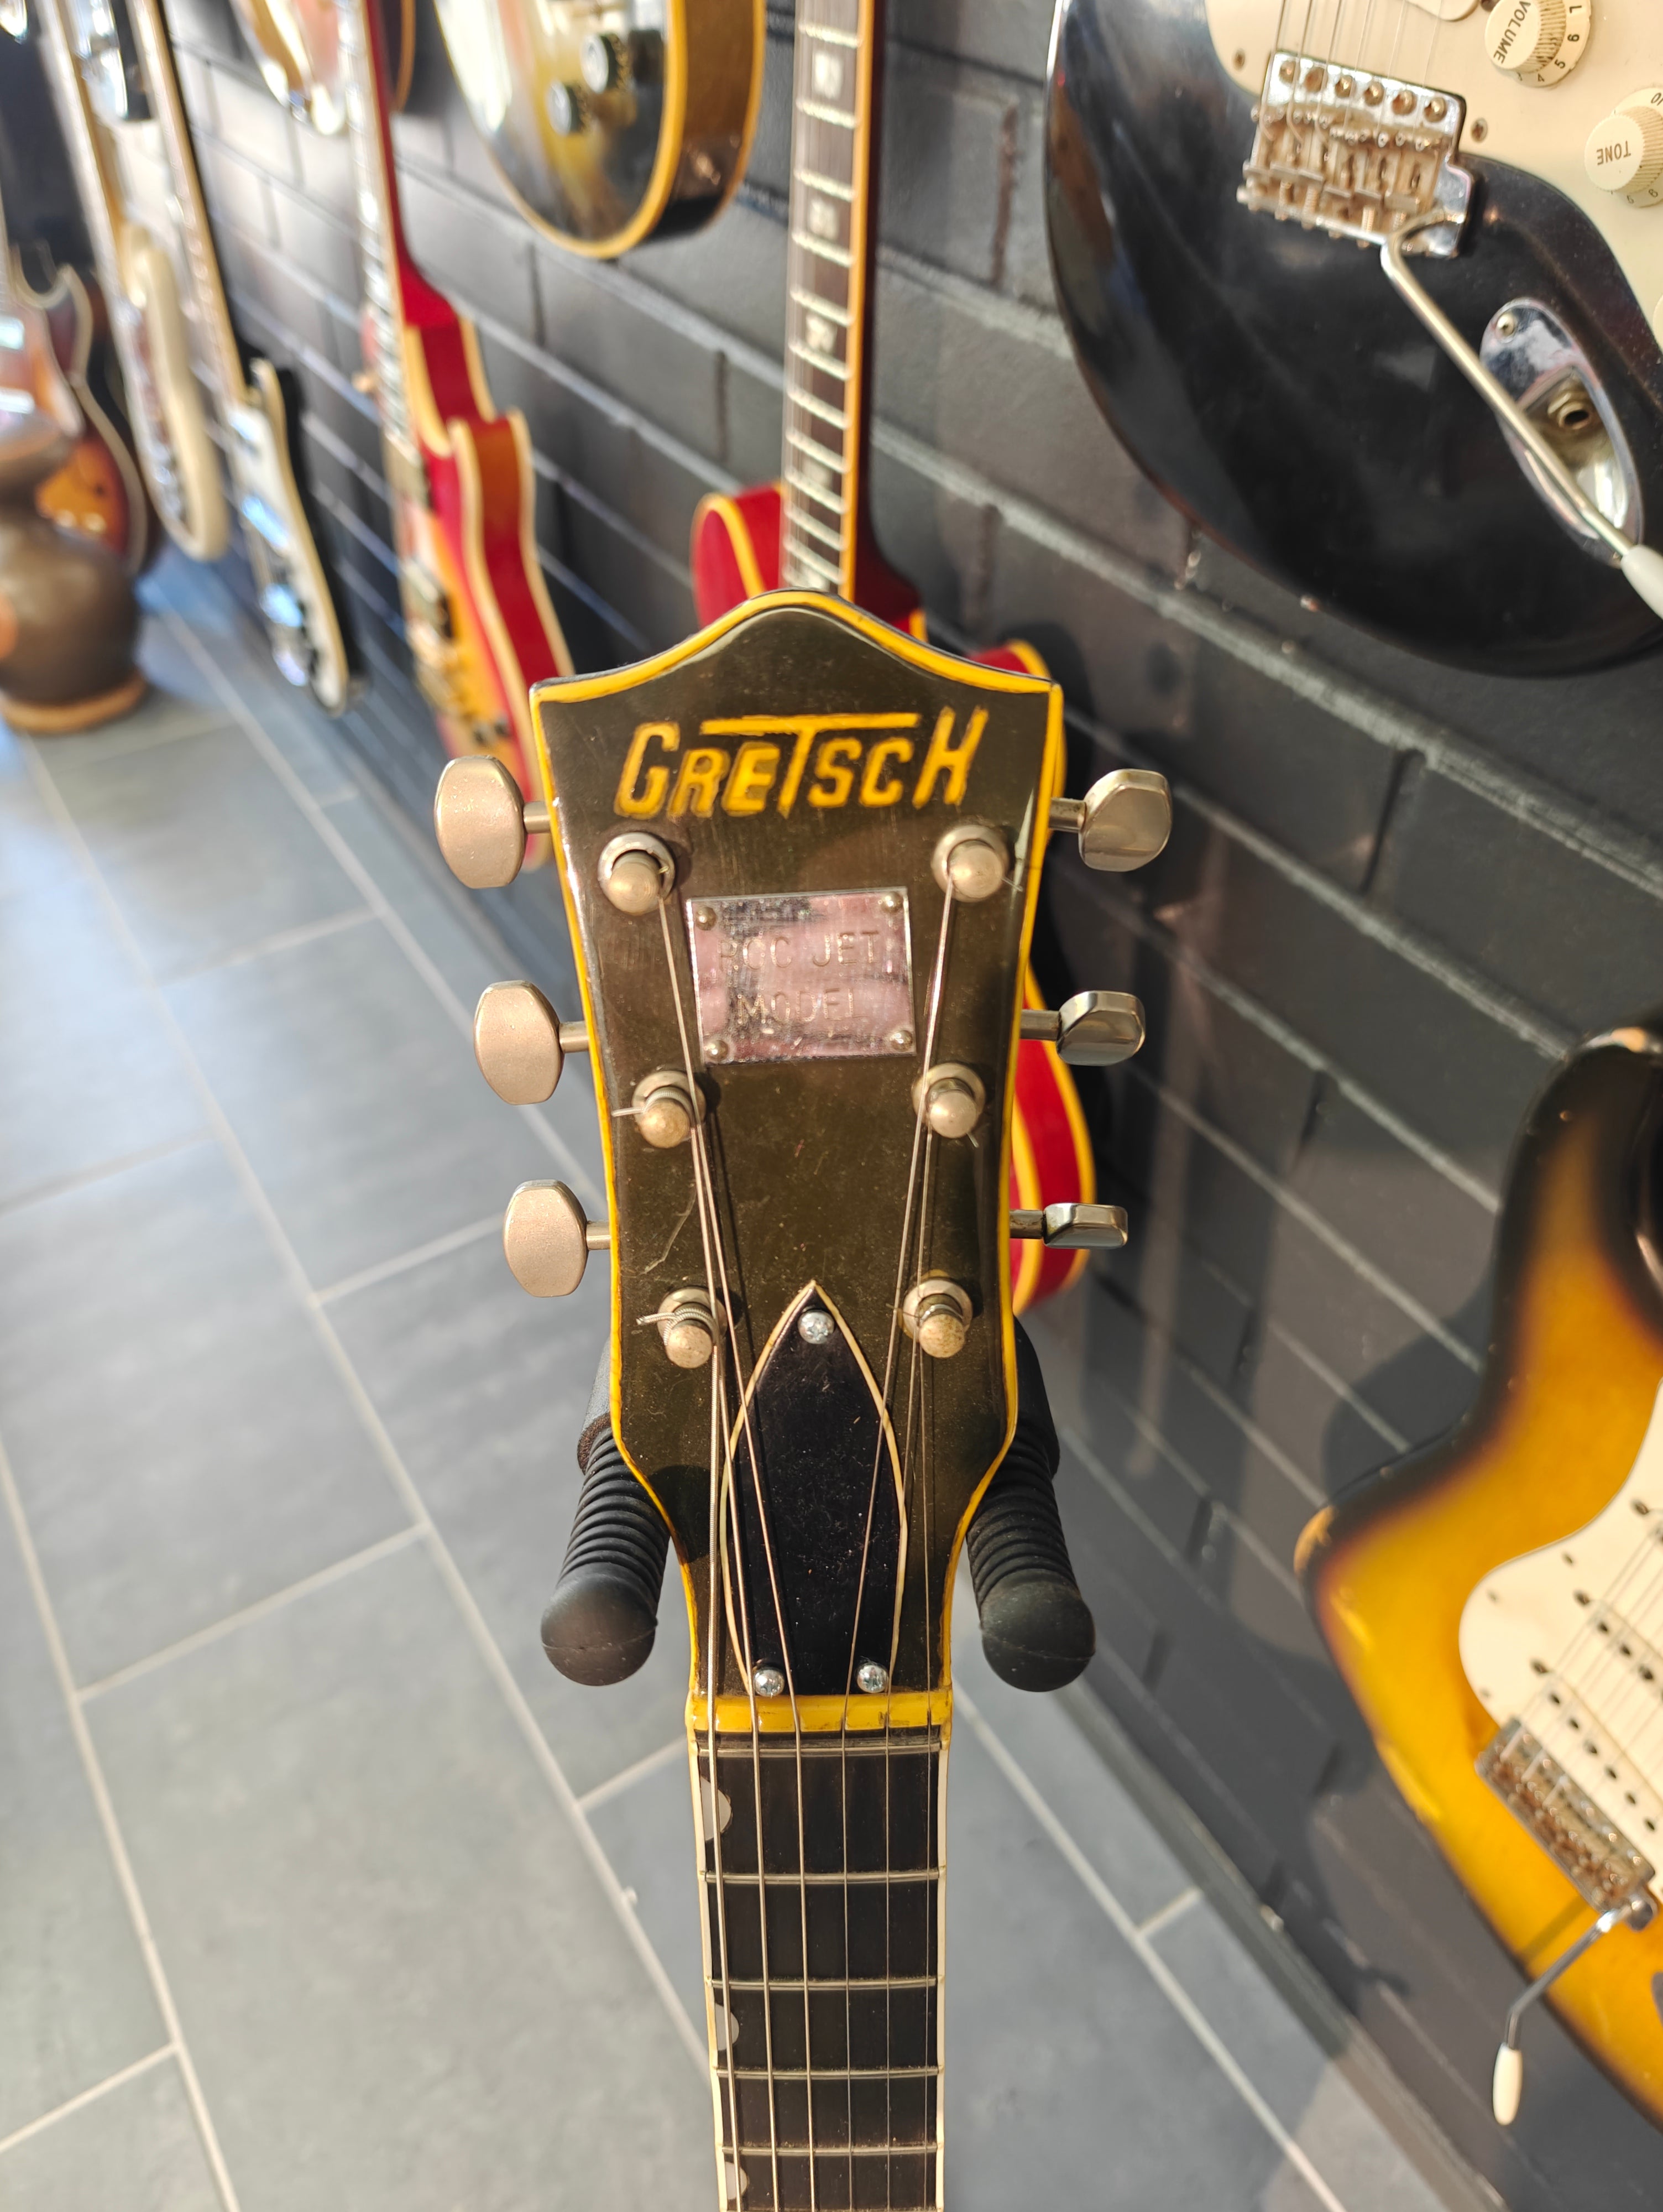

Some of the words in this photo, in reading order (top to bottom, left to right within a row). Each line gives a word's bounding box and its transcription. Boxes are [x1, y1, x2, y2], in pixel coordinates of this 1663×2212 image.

[1493, 1, 1531, 64] VOLUME
[1567, 33, 1580, 42] 6
[1554, 59, 1566, 69] 5
[1596, 140, 1631, 165] TONE
[812, 929, 879, 967] JET
[736, 988, 868, 1025] MODEL
